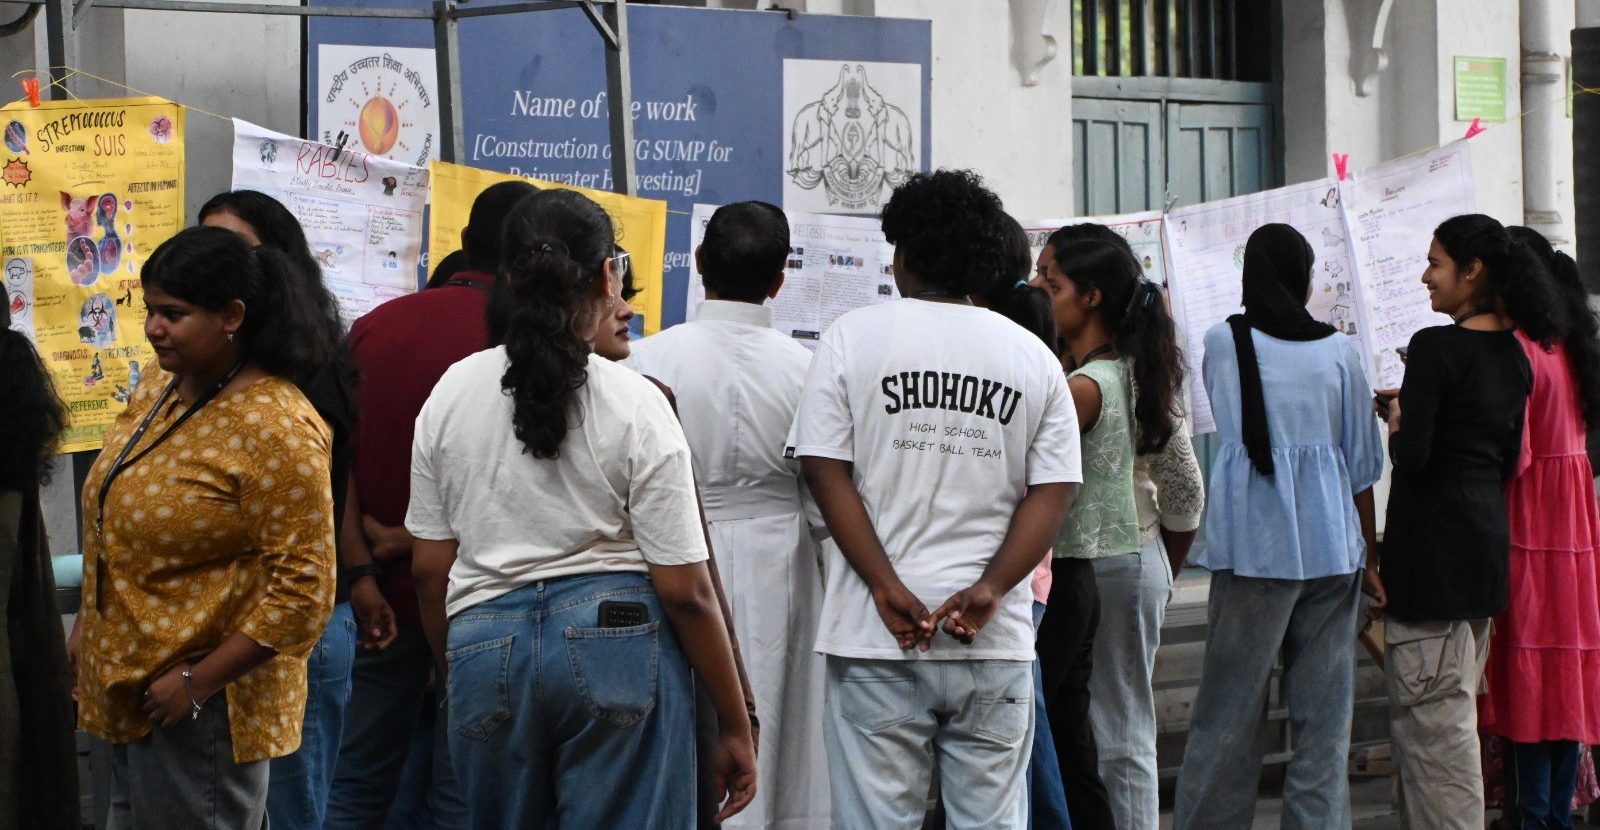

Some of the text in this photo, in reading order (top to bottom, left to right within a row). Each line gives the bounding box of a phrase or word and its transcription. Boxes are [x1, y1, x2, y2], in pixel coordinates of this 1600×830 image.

[383, 53, 403, 74] शिक्षा
[404, 68, 431, 108] अभियान
[511, 90, 575, 118] Name
[580, 91, 607, 119] of
[646, 94, 698, 121] work
[37, 110, 126, 153] STREPTOCOCCUS
[56, 144, 86, 154] INFECTION
[94, 133, 126, 157] SUIS
[296, 141, 370, 184] RABIES
[416, 133, 432, 167] ISSION
[473, 134, 733, 163] [Construction o G SUMP for
[601, 168, 702, 197] Hvesting]
[881, 370, 1022, 426] SHOHOKU
[909, 422, 988, 440] HIGH SCHOOL
[892, 439, 1002, 460] BASKET BALL TEAM
